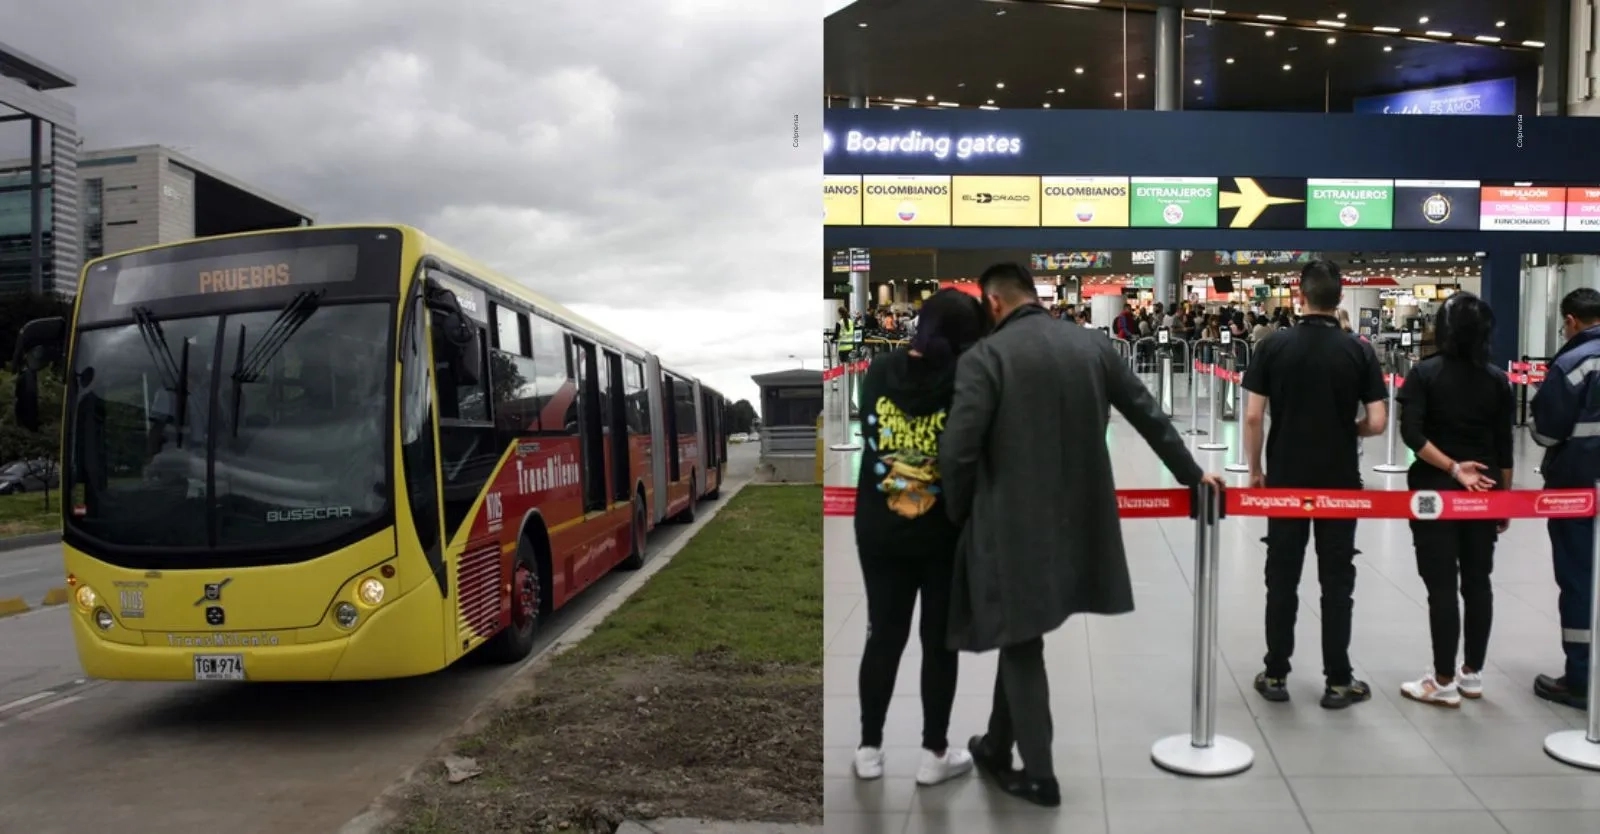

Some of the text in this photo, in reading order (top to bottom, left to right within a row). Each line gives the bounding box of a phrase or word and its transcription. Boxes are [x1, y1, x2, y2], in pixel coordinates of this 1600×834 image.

[1446, 99, 1481, 113] AMOR
[846, 130, 1021, 158] Boarding gates
[866, 185, 948, 195] COLOMBIANOS
[1044, 186, 1126, 196] COLOMBIANOS
[1136, 187, 1212, 197] EXTRANJEROS
[1313, 189, 1388, 200] EXTRANJEROS
[1494, 218, 1551, 226] FUNCIONARIOS
[199, 263, 290, 294] PRUEBAS
[516, 453, 579, 495] TransMilenio
[267, 506, 352, 522] BUSSCAR
[167, 632, 280, 647] TransMilenio
